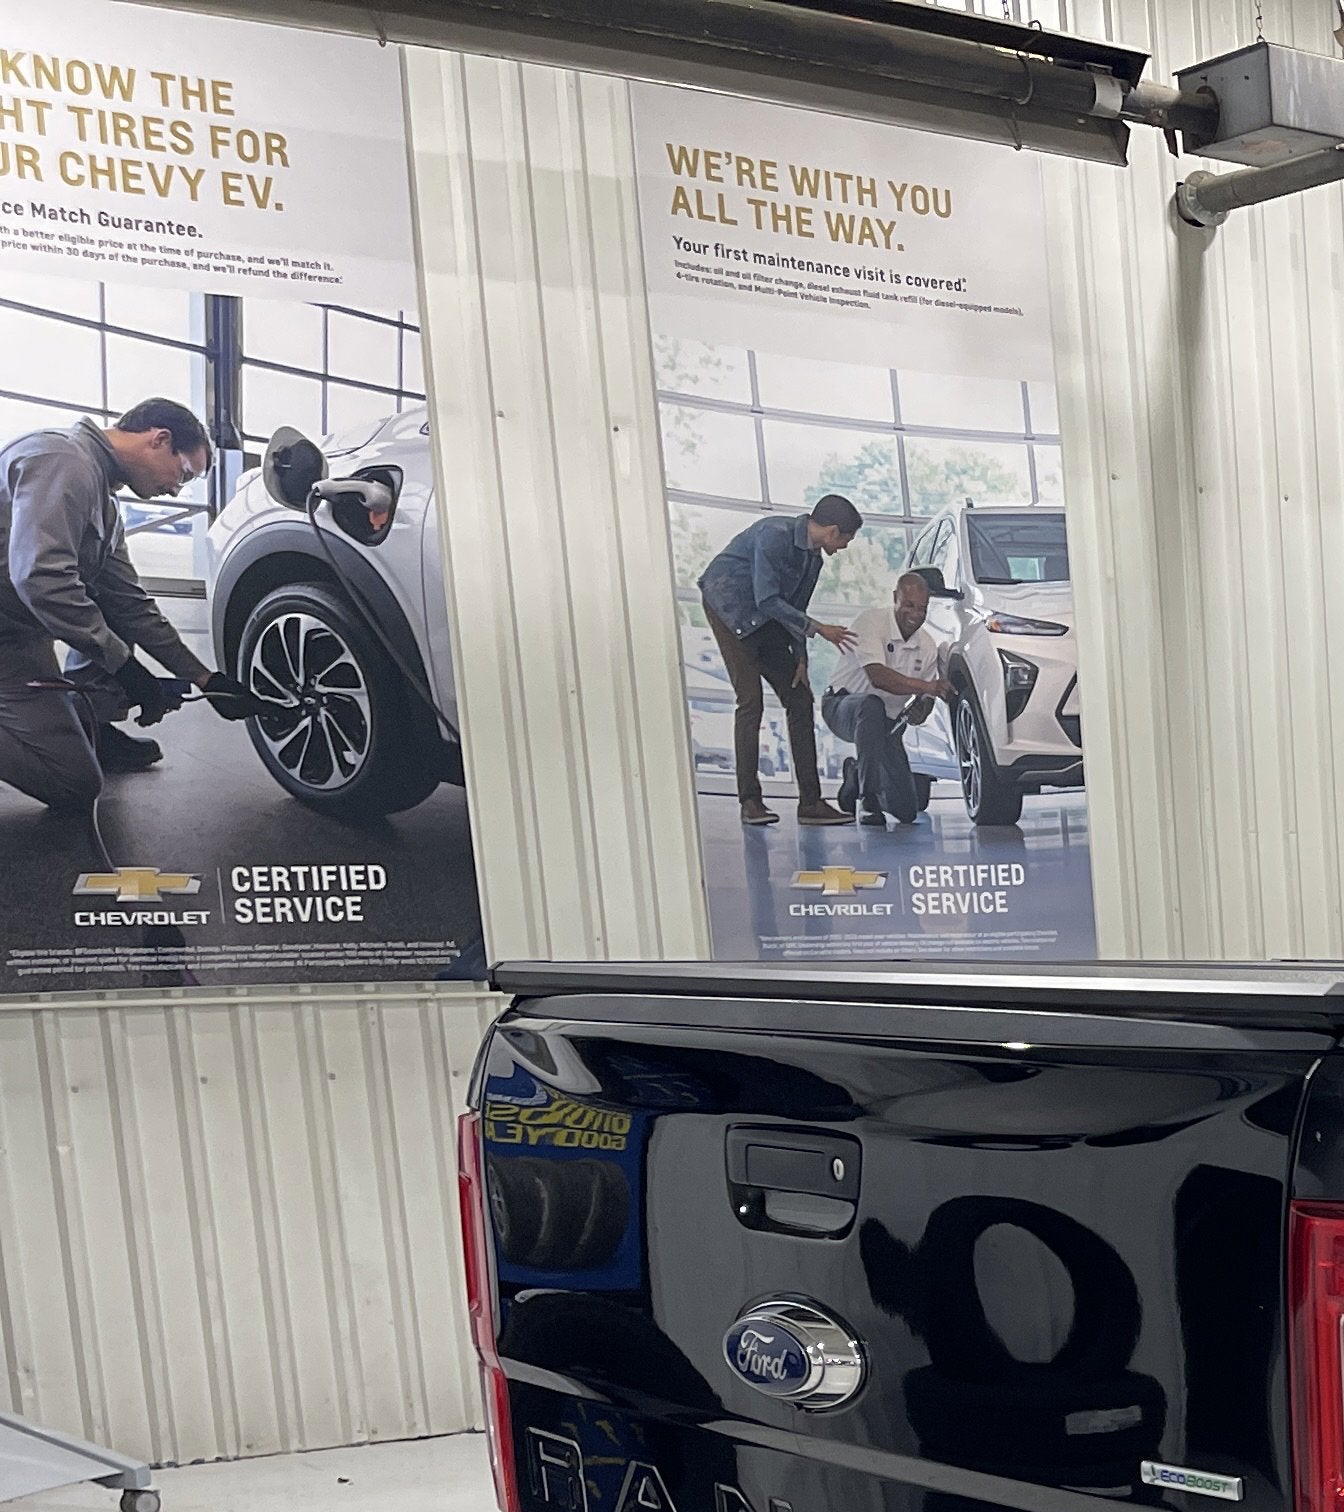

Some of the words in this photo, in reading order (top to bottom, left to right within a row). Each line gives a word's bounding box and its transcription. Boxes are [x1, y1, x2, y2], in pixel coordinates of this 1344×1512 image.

[0, 49, 136, 103] KNOW
[150, 71, 235, 116] THE
[67, 105, 195, 155] TIRES
[209, 125, 290, 168] FOR
[58, 151, 207, 201] CHEVY
[221, 171, 285, 211] EV.
[789, 164, 878, 208] WITH
[888, 180, 952, 218] YOU
[31, 202, 91, 225] Match
[97, 211, 203, 239] Guarantee.
[670, 185, 738, 227] ALL
[746, 197, 815, 239] THE
[824, 210, 905, 252] WAY.
[1, 240, 28, 250] price
[30, 242, 64, 255] within
[66, 247, 79, 257] 30
[82, 249, 106, 261] days
[109, 252, 119, 261] of
[121, 254, 138, 264] the
[141, 257, 191, 271] purchase,
[192, 262, 210, 272] and
[237, 265, 270, 278] refund
[272, 269, 289, 279] the
[22, 228, 55, 241] better
[58, 233, 95, 246] eligible
[98, 239, 125, 250] price
[127, 242, 138, 250] at
[140, 243, 157, 253] the
[159, 244, 181, 255] time
[184, 249, 194, 257] of
[197, 251, 245, 263] purchase,
[247, 255, 265, 264] and
[267, 257, 290, 267] we'll
[291, 261, 321, 271] match
[672, 235, 709, 254] Your
[714, 243, 749, 262] first
[753, 252, 850, 278] maintenance
[854, 265, 886, 283] visit
[890, 269, 901, 285] is
[231, 864, 387, 893] CERTIFIED
[909, 863, 1025, 888] CERTIFIED
[74, 909, 210, 927] CHEVROLET
[234, 896, 364, 925] SERVICE
[789, 902, 894, 917] CHEVROLET
[911, 891, 1009, 915] SERVICE
[737, 1329, 788, 1380] Ford
